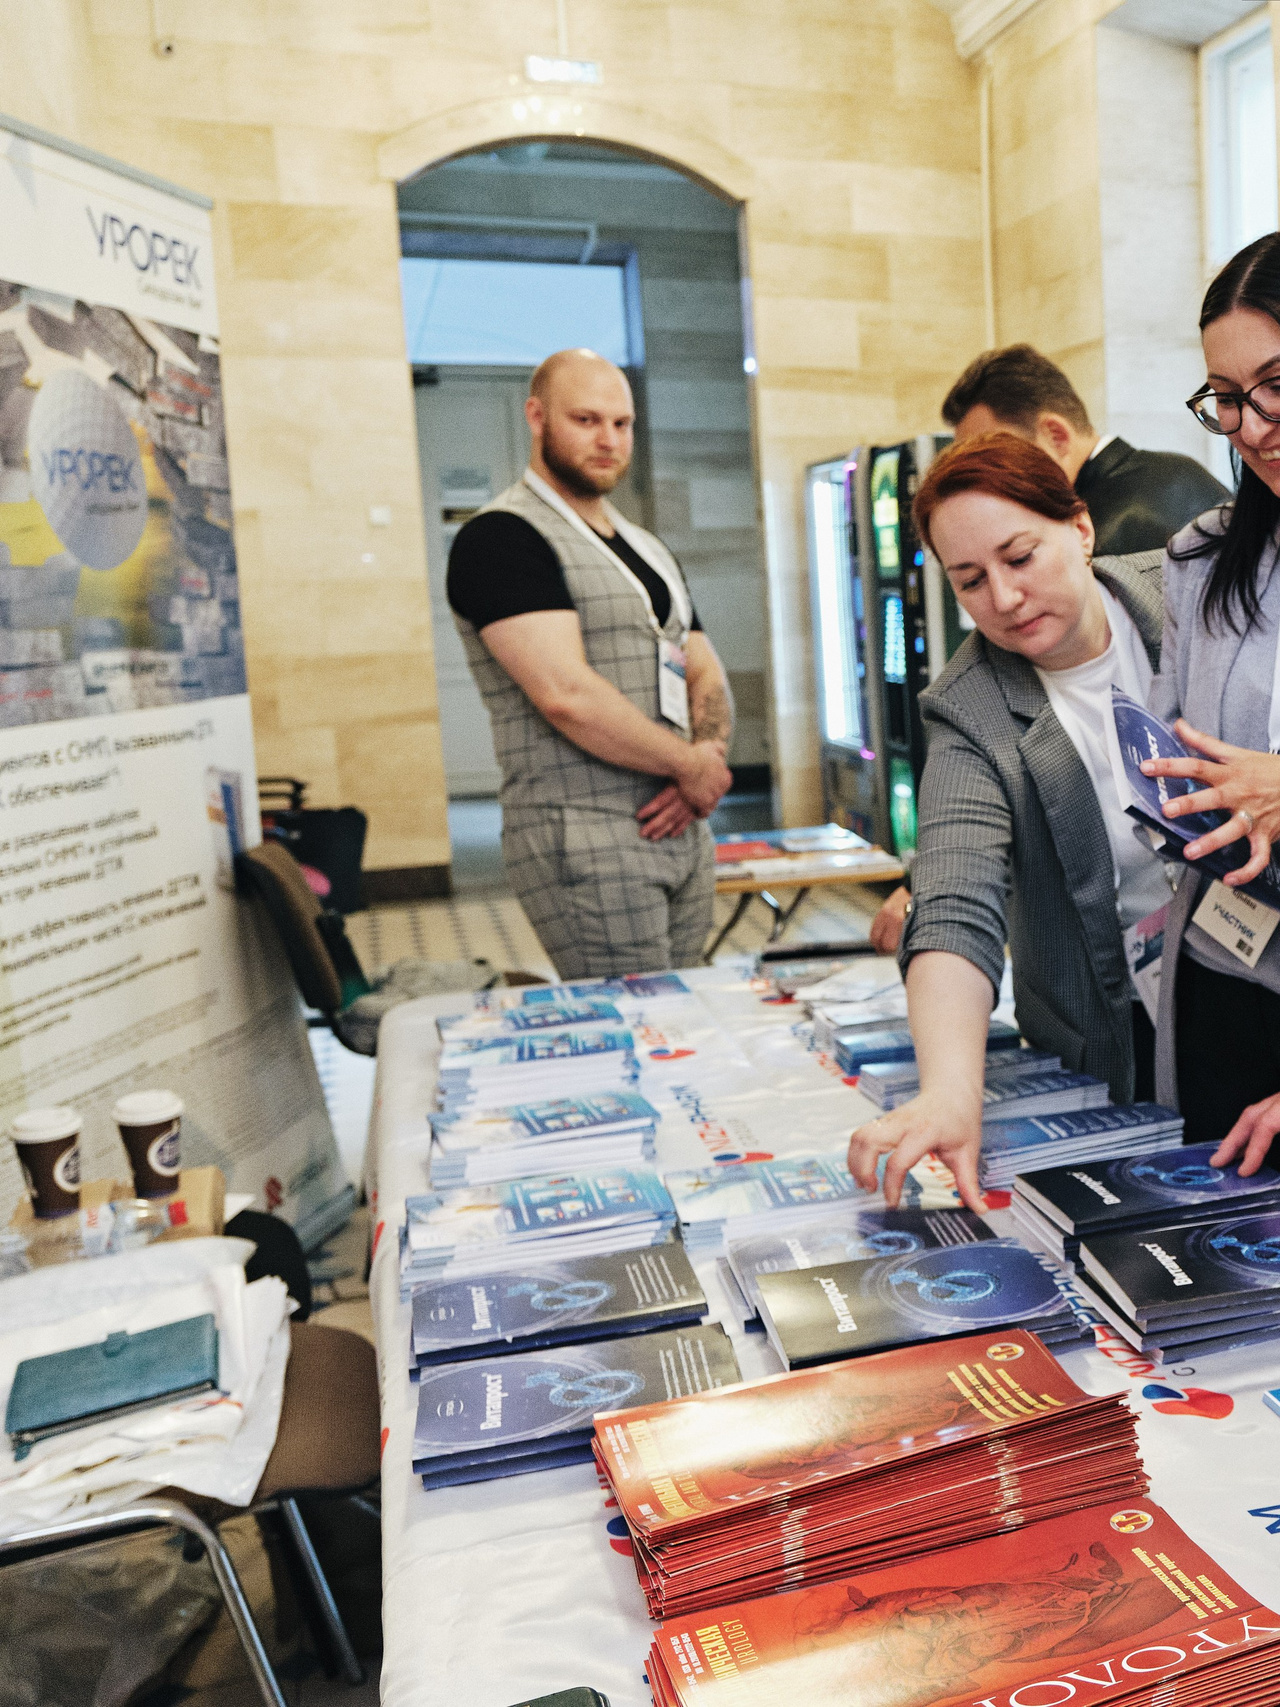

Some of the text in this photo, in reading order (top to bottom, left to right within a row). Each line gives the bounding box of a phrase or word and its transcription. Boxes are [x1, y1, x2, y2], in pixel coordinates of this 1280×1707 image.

[85, 205, 201, 290] УРОРЕК
[41, 448, 137, 494] УРОРЕК
[1213, 902, 1255, 940] УЧАСТНИК
[1141, 1242, 1194, 1287] Витапрост
[468, 1285, 494, 1331] Витапрост
[814, 1276, 858, 1334] Витапрост
[479, 1372, 510, 1431] Витапрост
[696, 1626, 740, 1679] НИЧЕСКАЯ
[722, 1619, 759, 1664] UROLOGY
